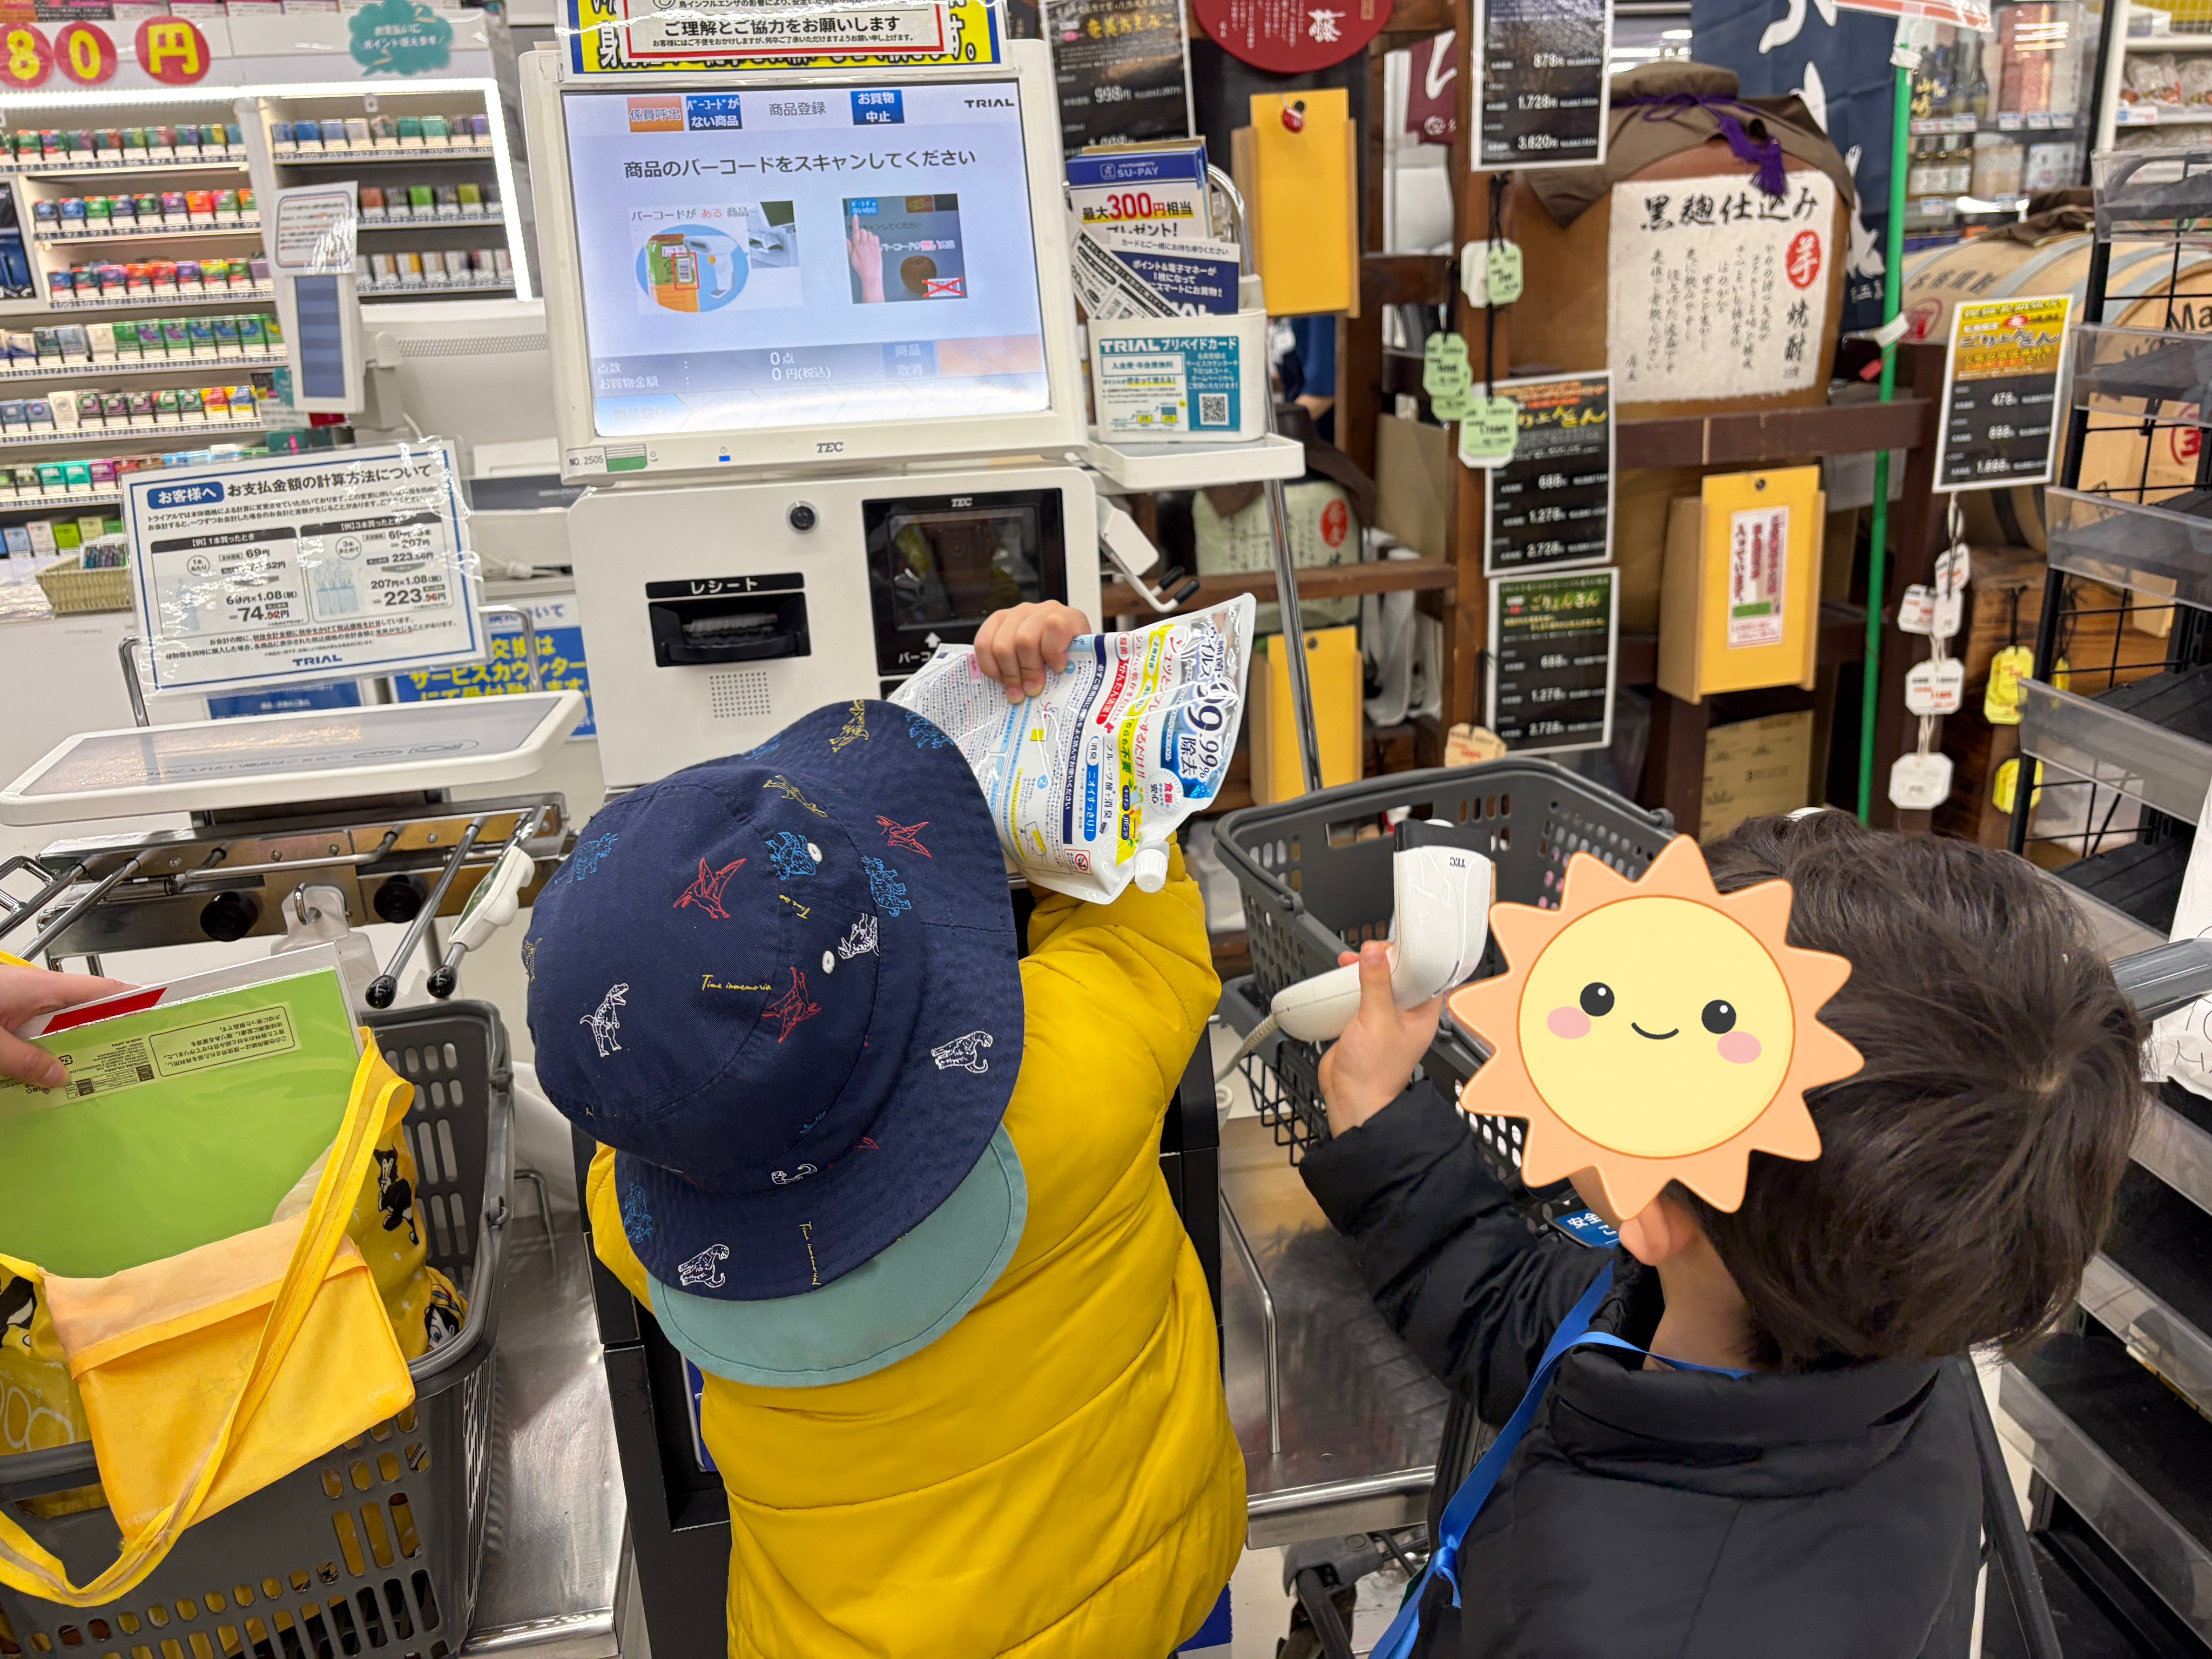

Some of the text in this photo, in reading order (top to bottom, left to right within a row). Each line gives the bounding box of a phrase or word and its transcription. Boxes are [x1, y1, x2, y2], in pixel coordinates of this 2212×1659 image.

[664, 16, 900, 37] ご理解とご協力をお願いします
[652, 36, 914, 48] お客様にはご不便をおかけしますが、何卒ご了承いただけますようお願い申し上げます。
[858, 92, 895, 105] お買物
[965, 98, 1015, 109] TRIAL
[630, 108, 682, 122] 係員呼出
[769, 102, 826, 116] 商品登録
[866, 111, 891, 123] 中止
[691, 115, 739, 128] ない商品
[624, 150, 976, 179] 商品のバーコードをスキャンしてください
[1116, 166, 1159, 178] SU-PAY
[631, 206, 749, 221] バーコードが ある 商品
[1082, 192, 1192, 221] 最大300円相当
[1783, 297, 1811, 363] 焼酎
[895, 343, 922, 357] 商品
[1101, 338, 1238, 353] TRIAL プリペイドカード
[597, 352, 795, 375] 点数 0 点
[896, 363, 923, 377] 取消
[598, 376, 659, 390] お買物金額
[771, 367, 781, 381] 0
[817, 442, 844, 453] TEC
[583, 455, 604, 465] 2505
[158, 463, 431, 505] お客様へ お支払金額の計算方法について
[950, 497, 973, 508] TEC
[246, 548, 270, 558] 69円
[690, 578, 759, 595] レシート
[1118, 637, 1128, 655] 除菌
[293, 654, 343, 667] TRIAL
[1089, 741, 1098, 761] 消臭
[1181, 736, 1198, 779] 除去
[1123, 788, 1131, 808] キッチン
[1150, 783, 1158, 804] 安心
[1085, 771, 1097, 833] ニオイすっきり!
[1449, 856, 1466, 868] TEC
[219, 1014, 281, 1033] 大切に使った製品です。
[190, 1021, 284, 1047] 地球環境に配慮し、限りある資源を
[163, 1028, 286, 1060] 育てた森林の木材と組み合わせて作りました。
[164, 1035, 287, 1067] この色画用紙は一度使用された紙を再利用し、
